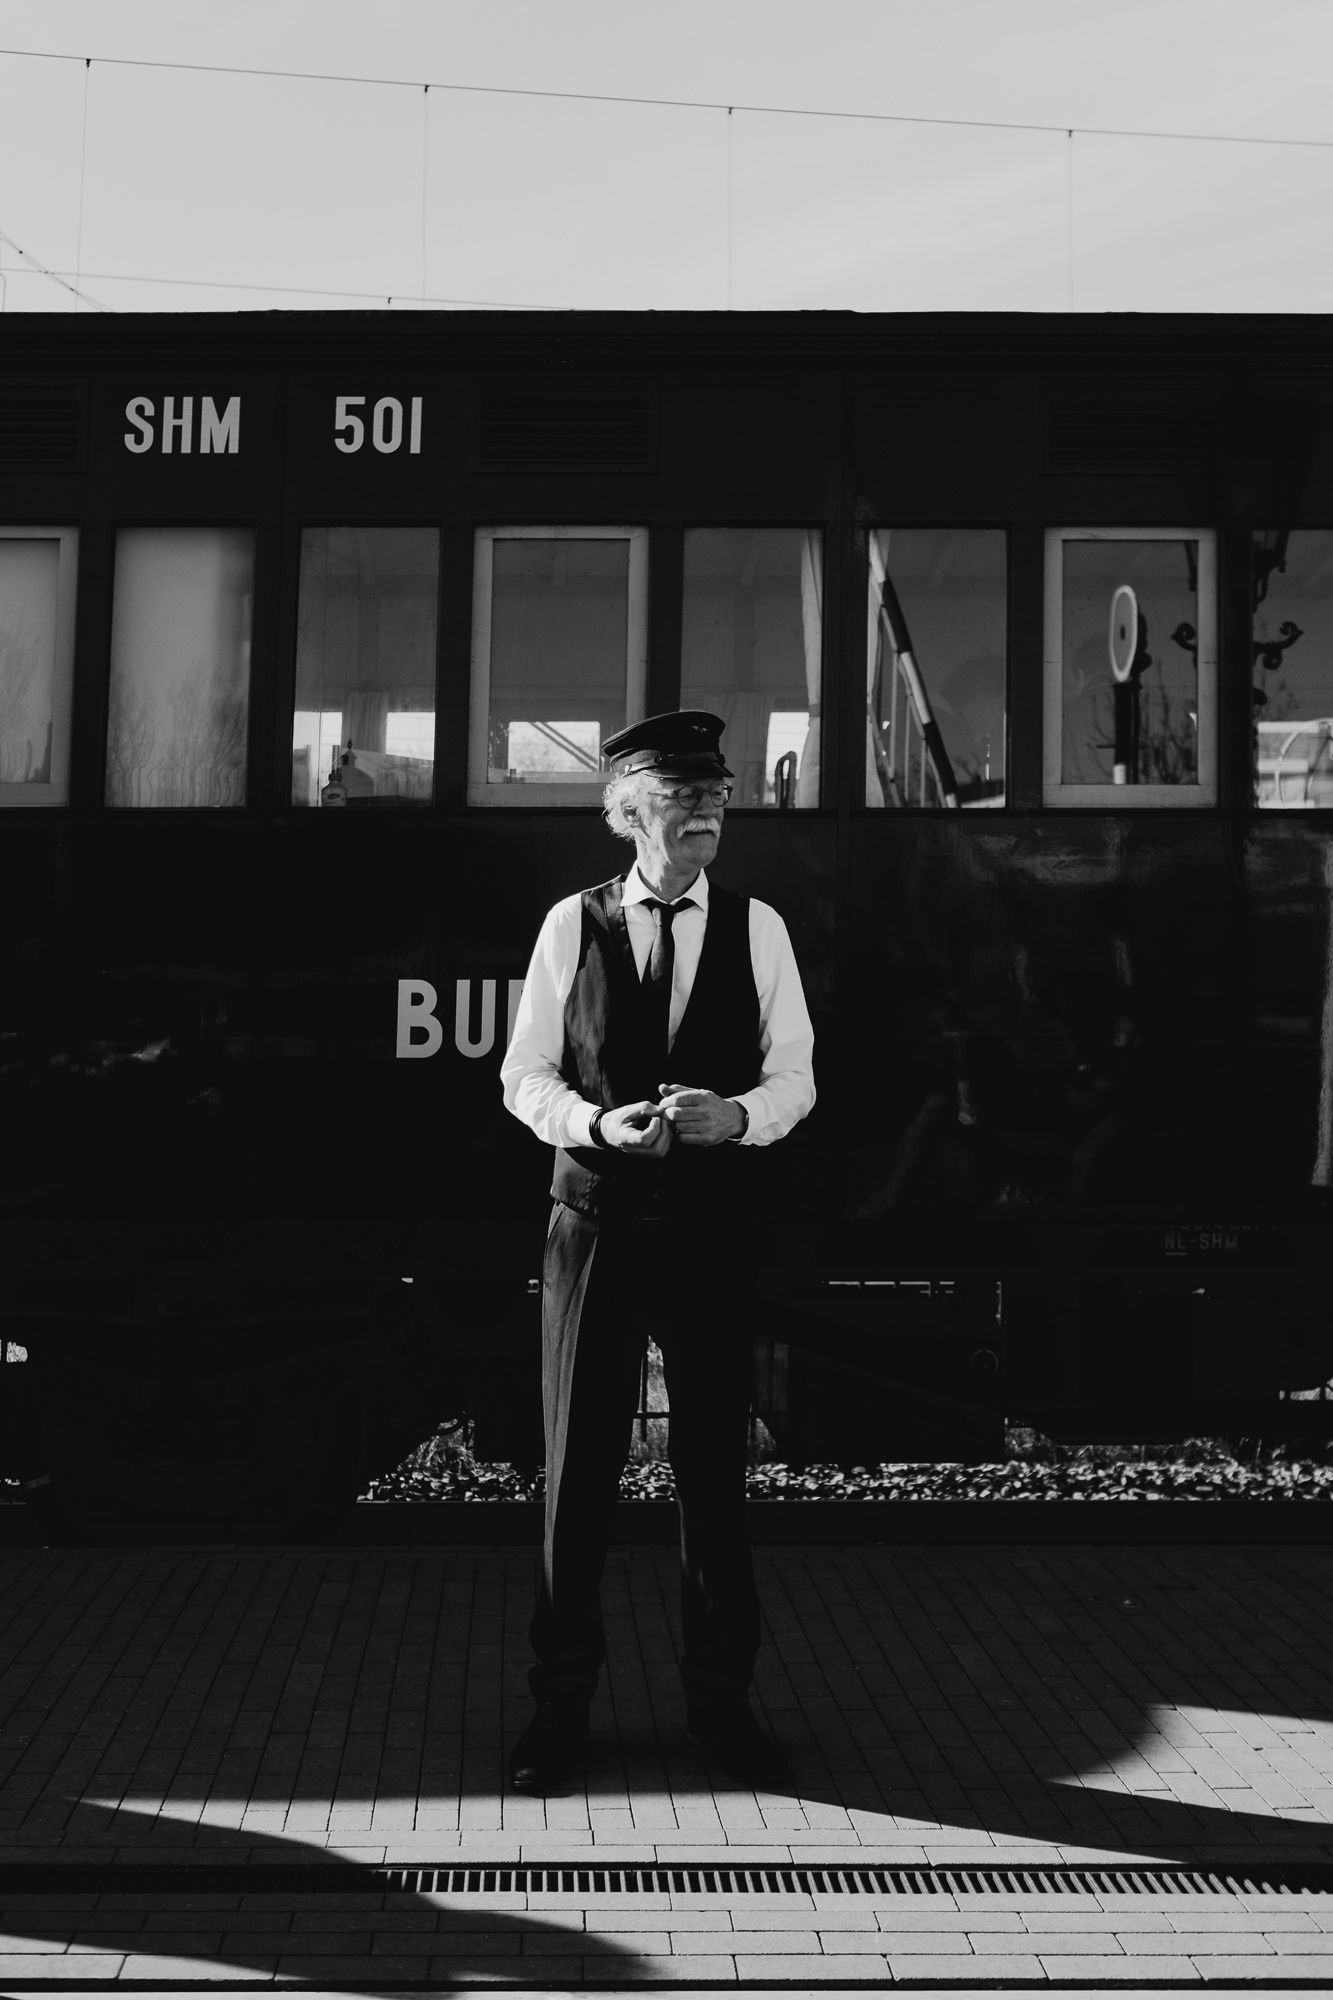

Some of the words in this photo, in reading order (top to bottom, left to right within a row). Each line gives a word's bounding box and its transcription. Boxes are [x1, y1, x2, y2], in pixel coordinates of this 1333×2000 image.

[124, 396, 241, 454] SHM
[334, 396, 423, 454] 501
[1164, 1233, 1239, 1250] NL-SHM
